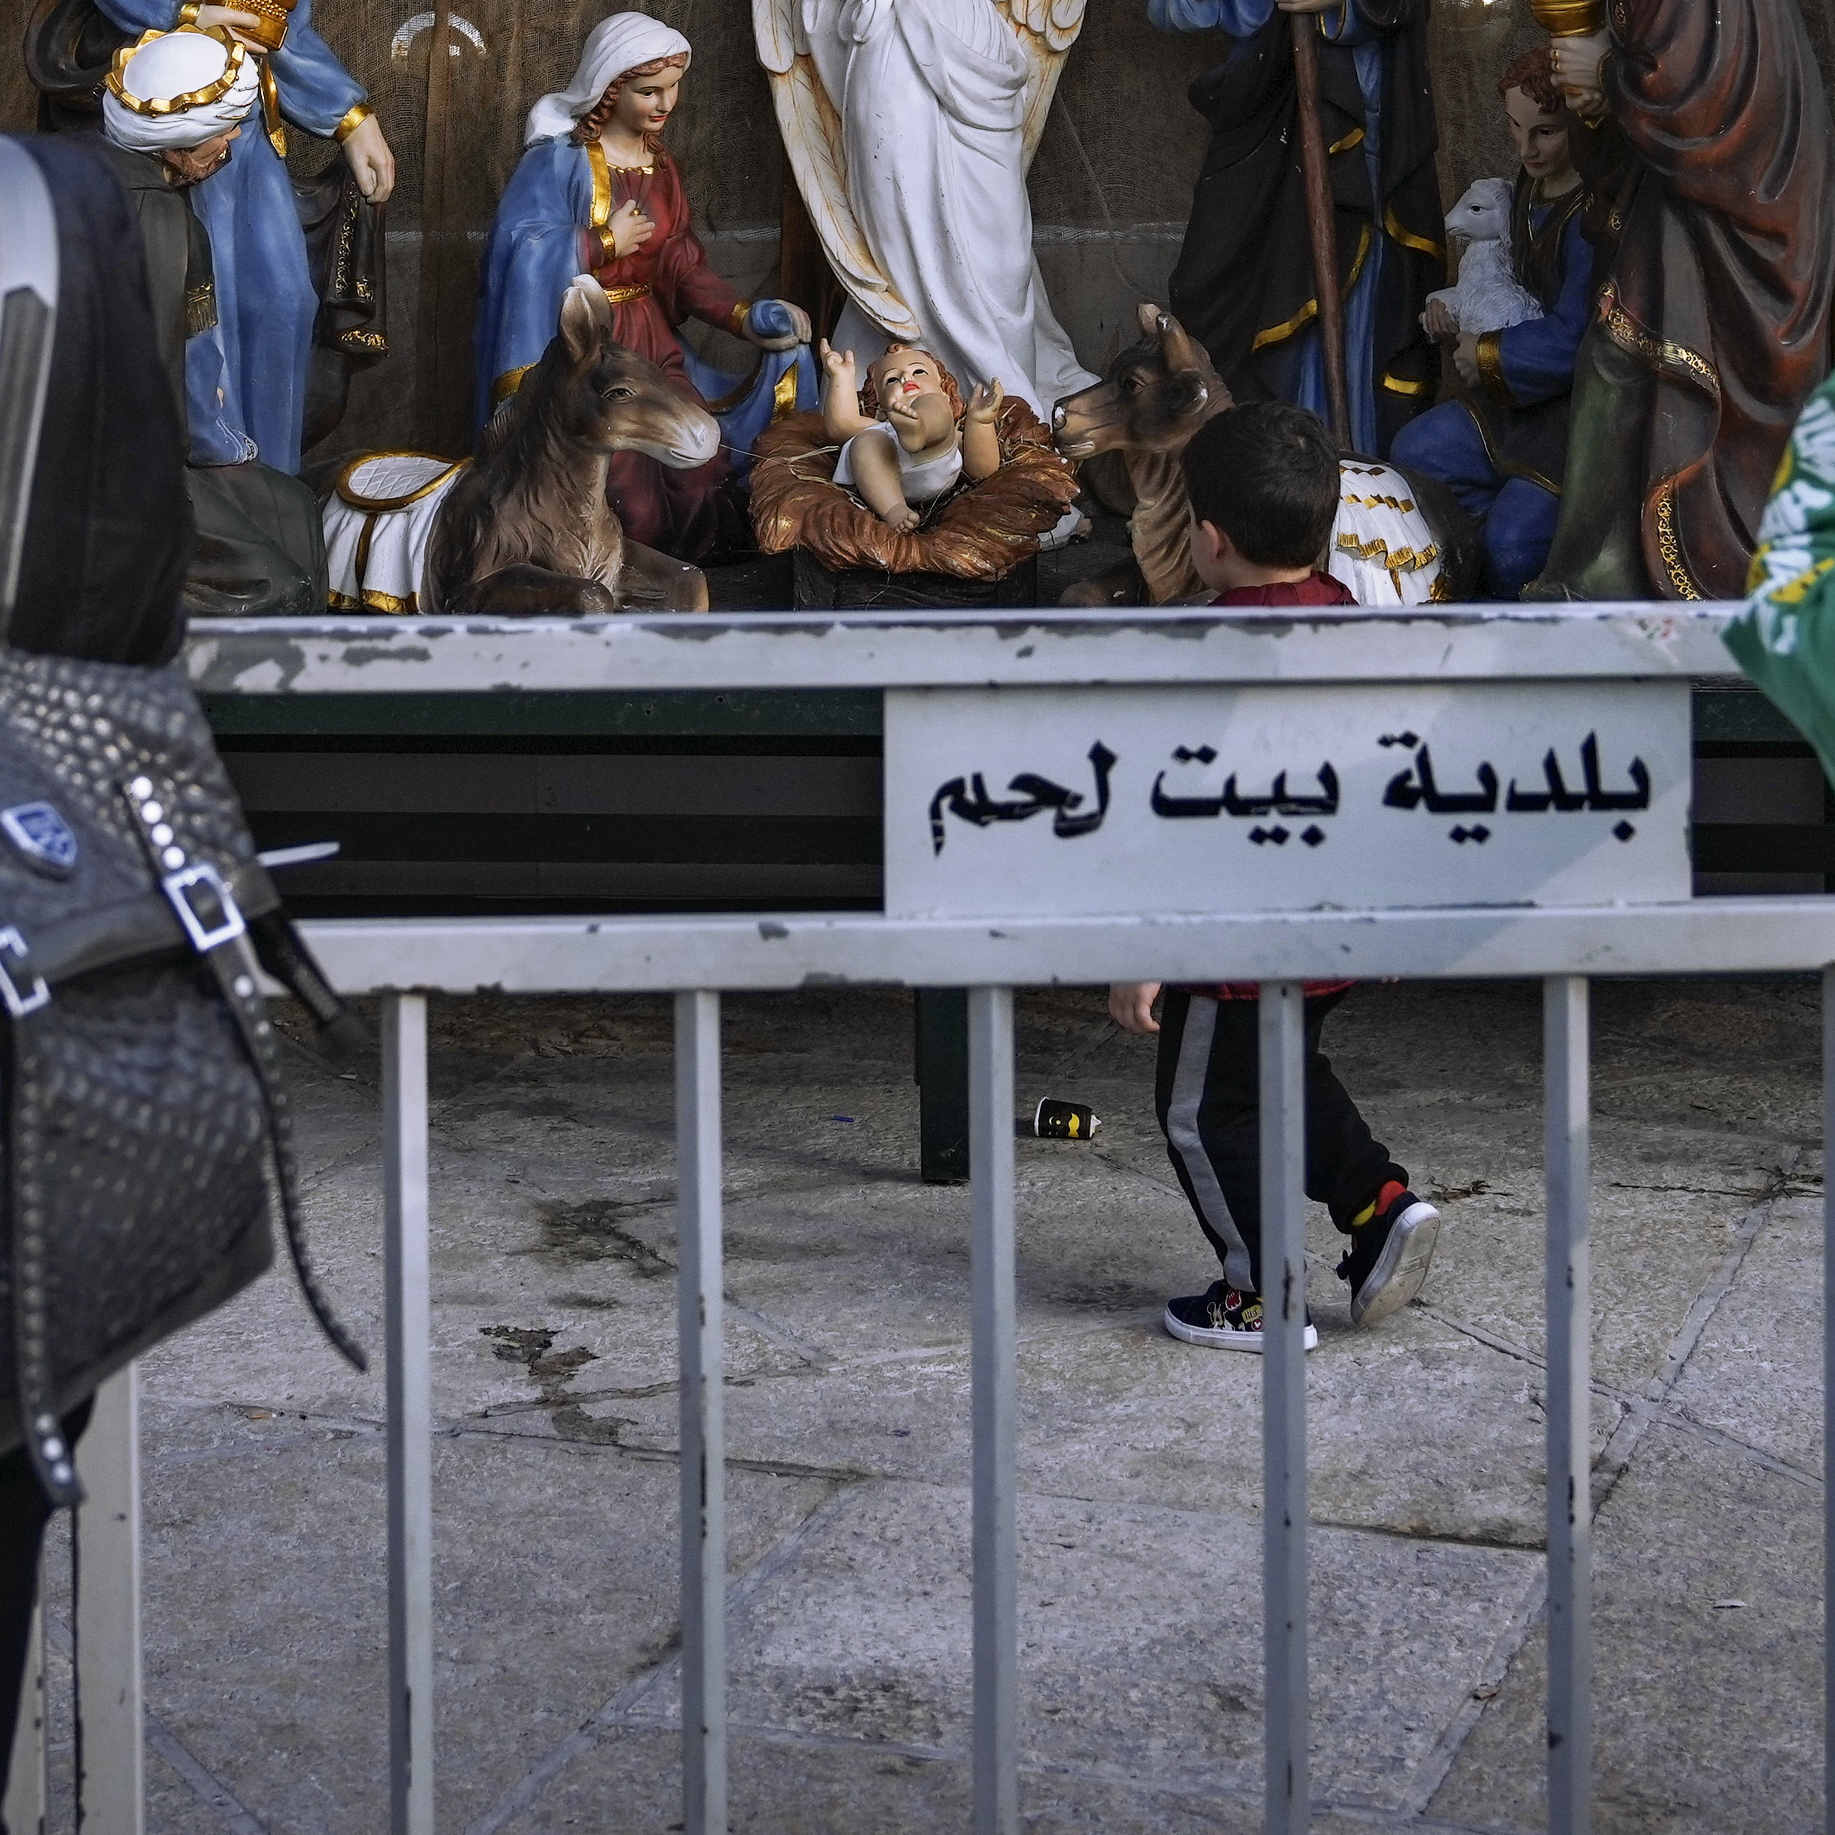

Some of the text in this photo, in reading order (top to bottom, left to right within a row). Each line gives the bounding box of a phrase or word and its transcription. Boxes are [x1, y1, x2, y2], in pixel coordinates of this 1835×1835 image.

[928, 729, 1652, 858] بلدية بيت لحم
